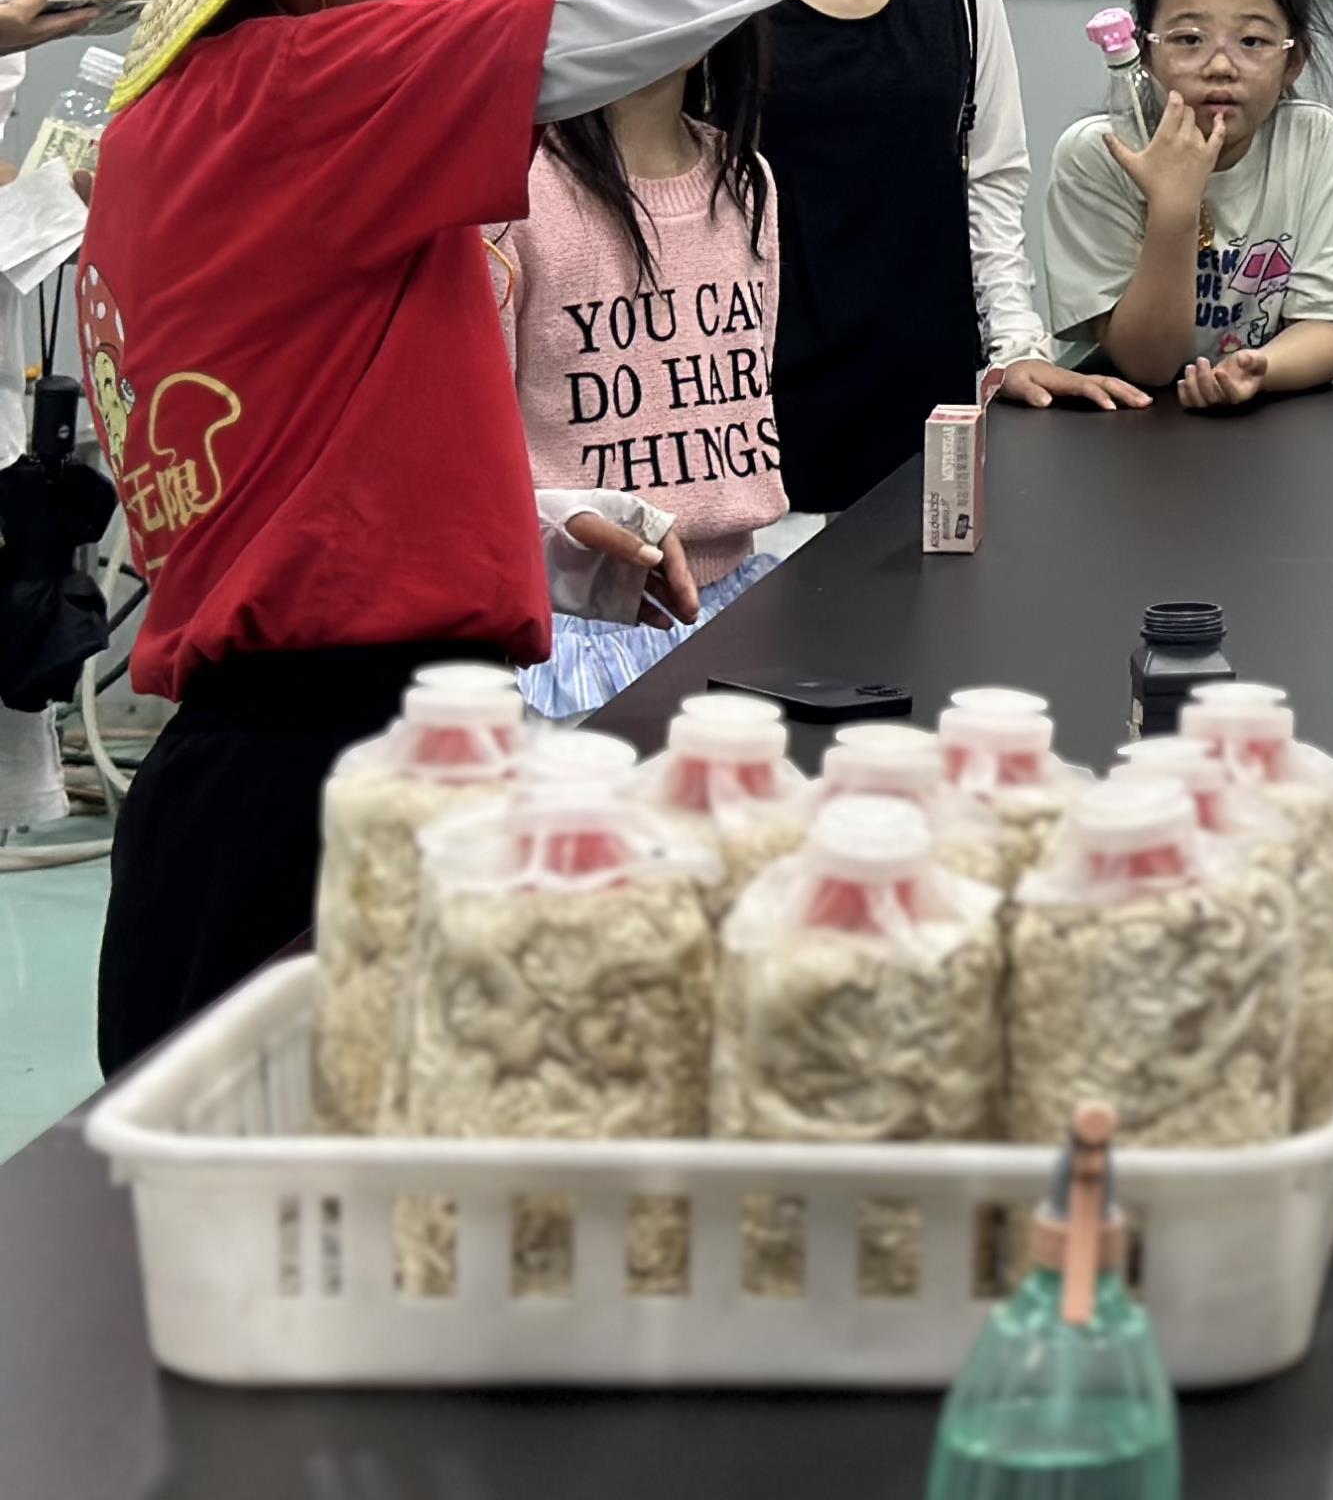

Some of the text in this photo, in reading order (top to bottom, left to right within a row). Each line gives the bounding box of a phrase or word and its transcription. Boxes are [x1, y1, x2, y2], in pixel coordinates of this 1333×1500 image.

[562, 288, 677, 354] YOU
[564, 363, 642, 425] DO
[581, 416, 781, 492] THINGS
